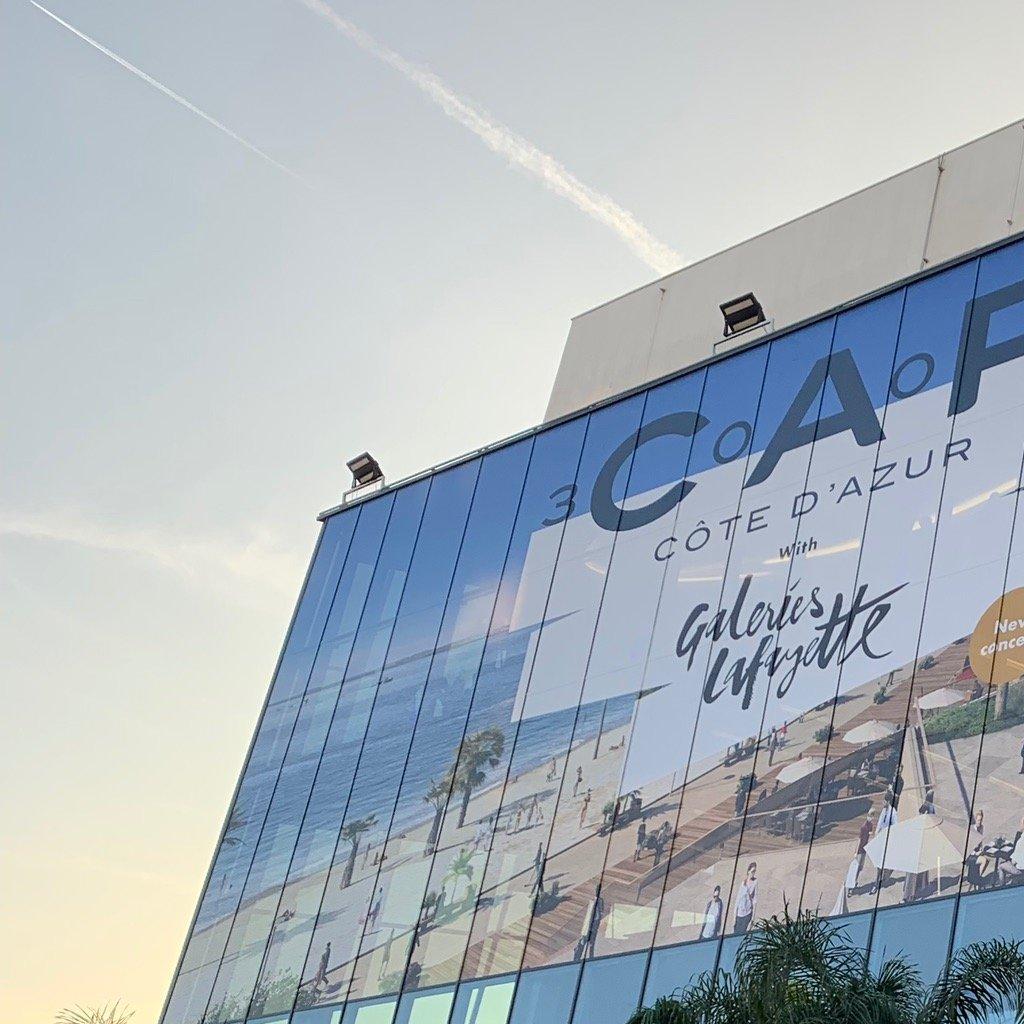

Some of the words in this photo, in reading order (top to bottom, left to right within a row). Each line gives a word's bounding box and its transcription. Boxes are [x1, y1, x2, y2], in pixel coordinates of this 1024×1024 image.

[653, 505, 771, 562] CÔTE
[791, 437, 972, 519] D'AZUR
[675, 574, 824, 671] Galeries
[703, 582, 910, 710] Lafayette
